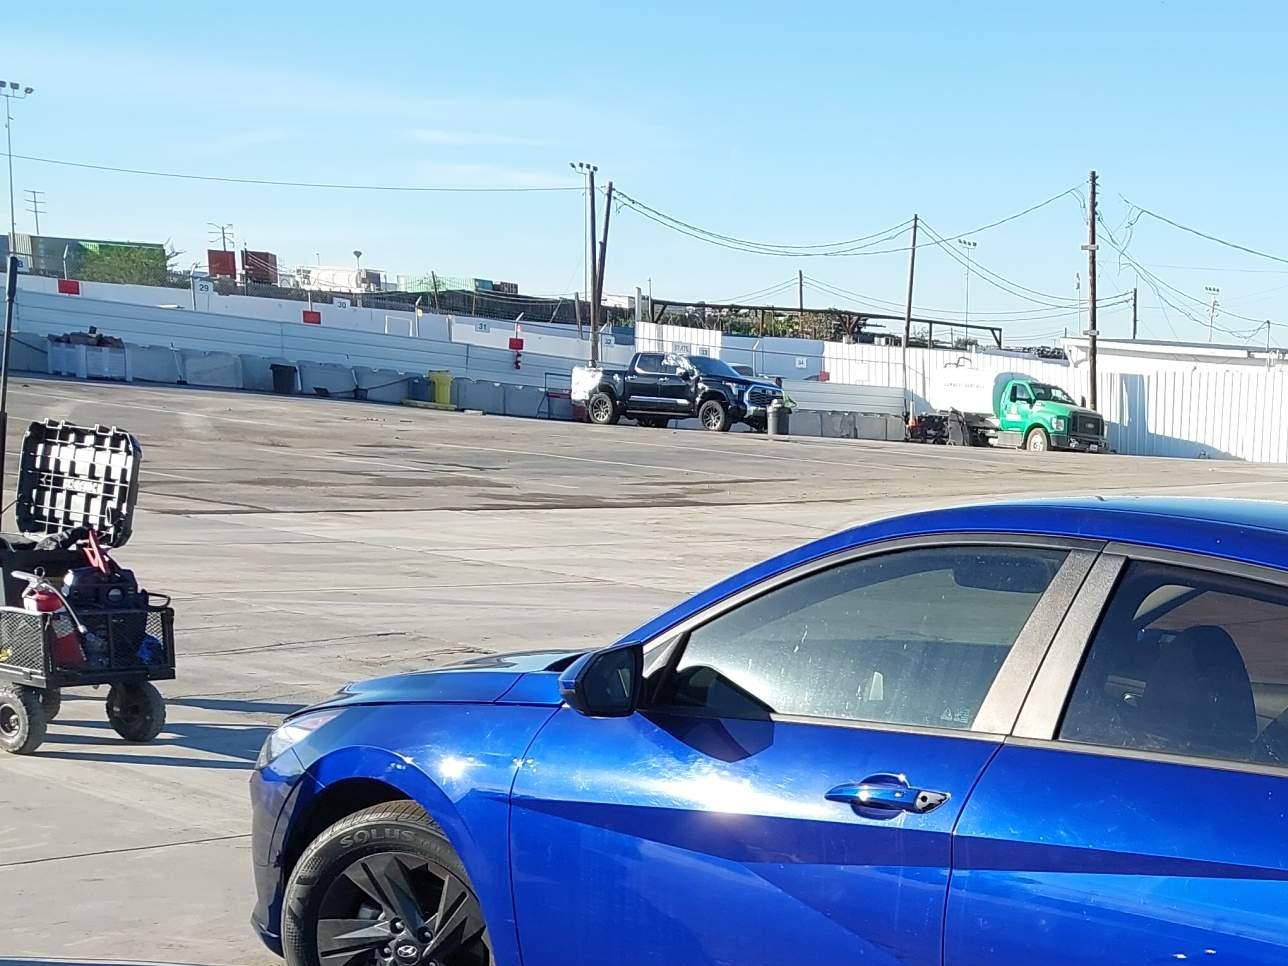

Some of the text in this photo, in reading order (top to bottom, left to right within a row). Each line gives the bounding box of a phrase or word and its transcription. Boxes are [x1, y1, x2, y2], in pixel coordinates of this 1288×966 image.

[199, 283, 209, 292] 29
[478, 322, 487, 330] 31
[340, 828, 416, 848] SOLUS
